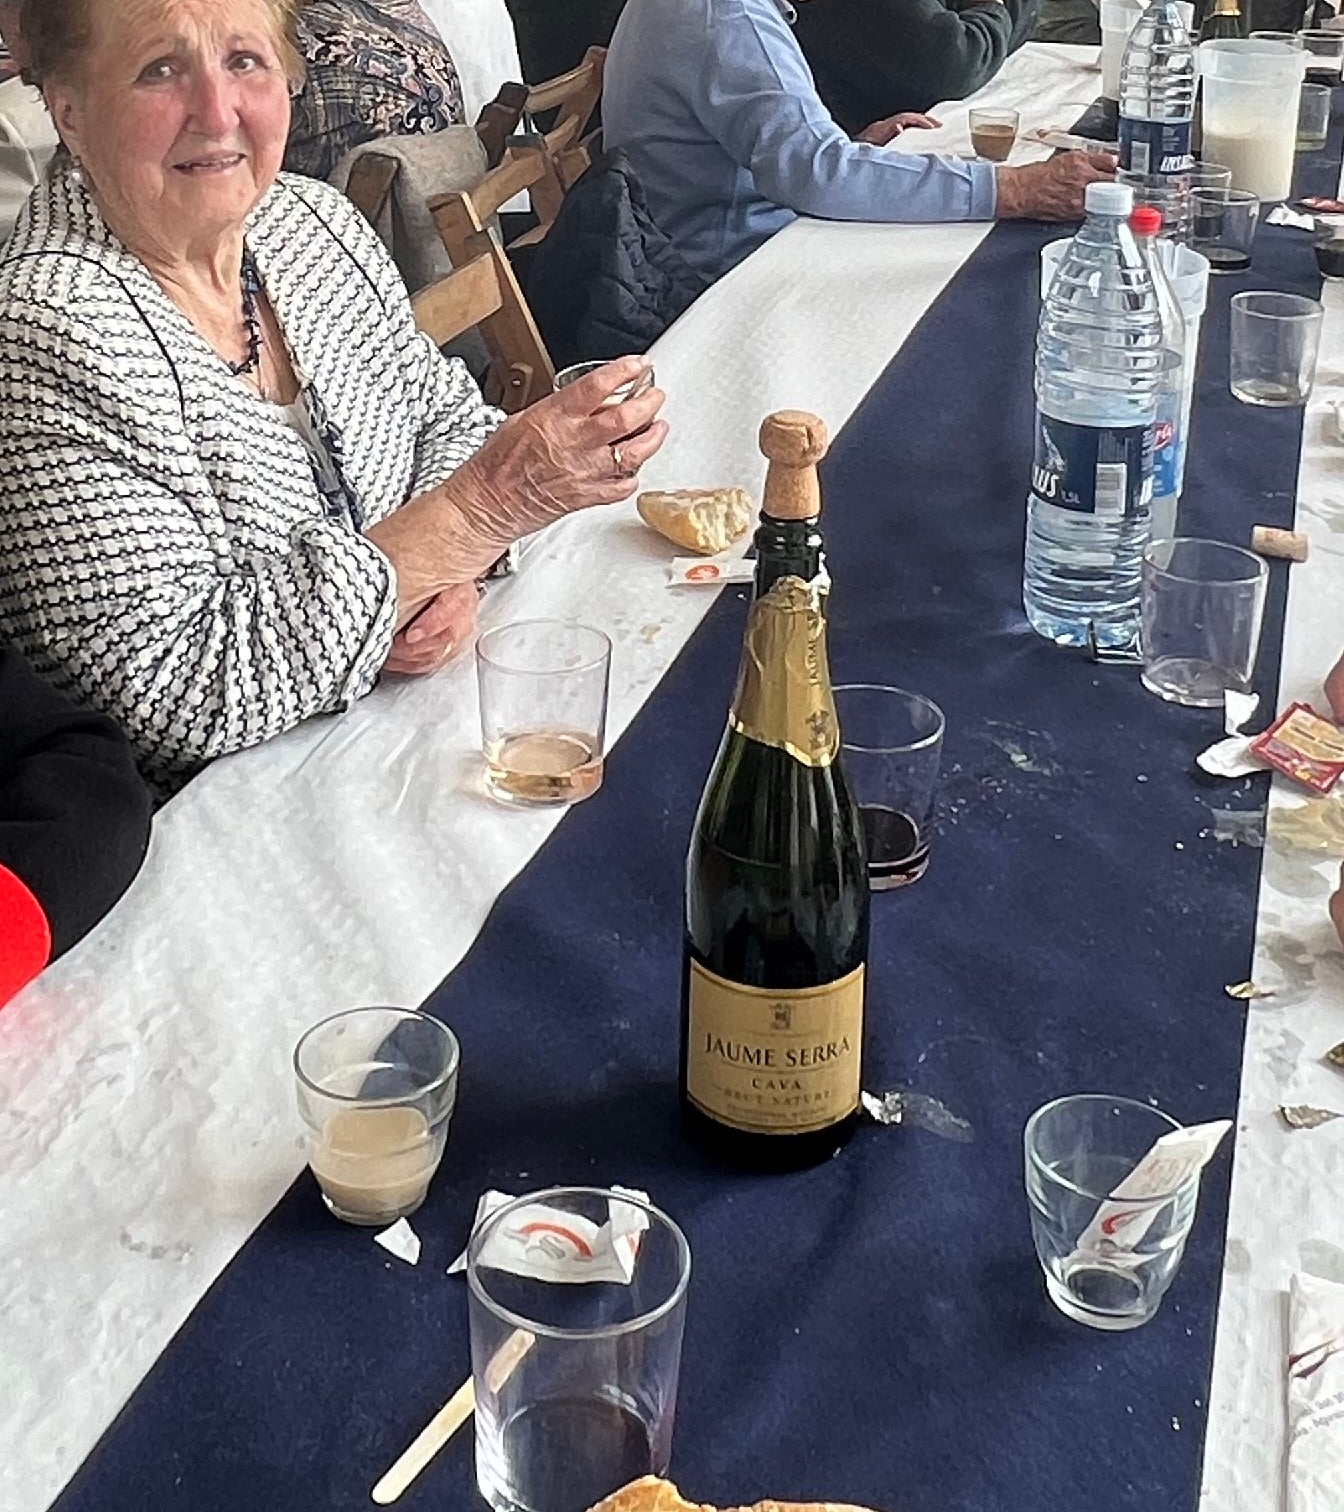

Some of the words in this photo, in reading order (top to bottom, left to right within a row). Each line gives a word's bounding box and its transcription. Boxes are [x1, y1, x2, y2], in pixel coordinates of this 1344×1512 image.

[706, 1032, 777, 1068] JAUME
[785, 1036, 851, 1068] SERRA
[752, 1078, 802, 1091] CAVA
